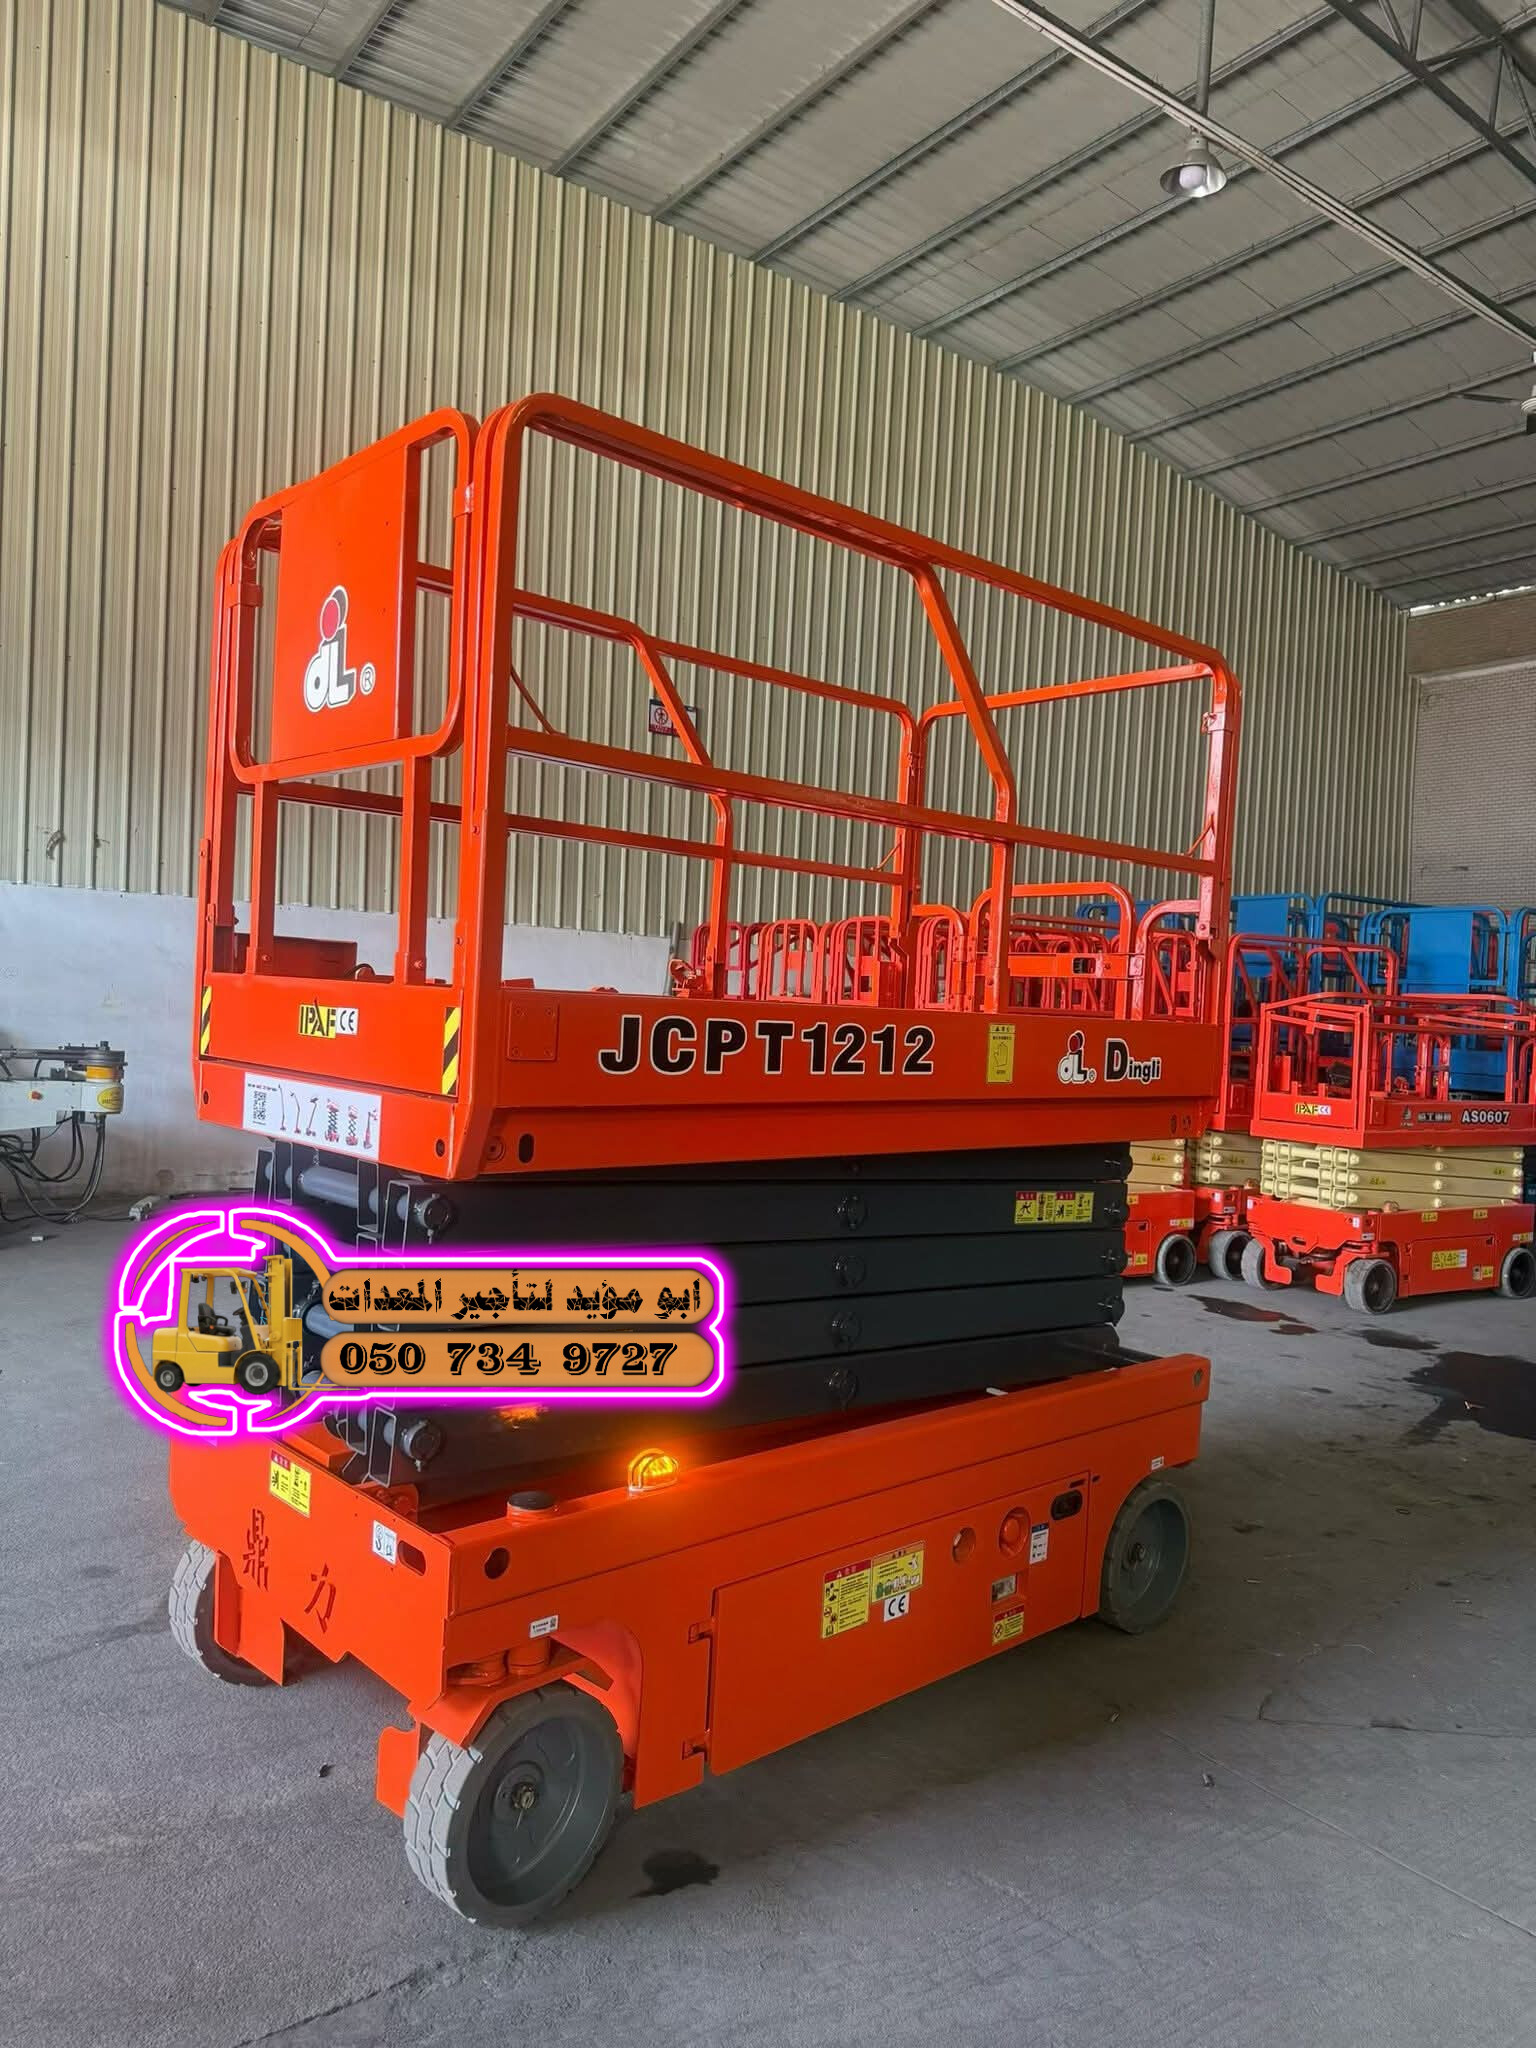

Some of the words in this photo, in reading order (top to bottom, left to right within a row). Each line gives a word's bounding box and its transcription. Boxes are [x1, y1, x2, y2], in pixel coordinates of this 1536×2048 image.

[300, 1000, 336, 1036] IPAF
[598, 1015, 935, 1075] JCPT1212
[1105, 1038, 1161, 1084] Dingli
[1461, 1109, 1511, 1125] AS0607
